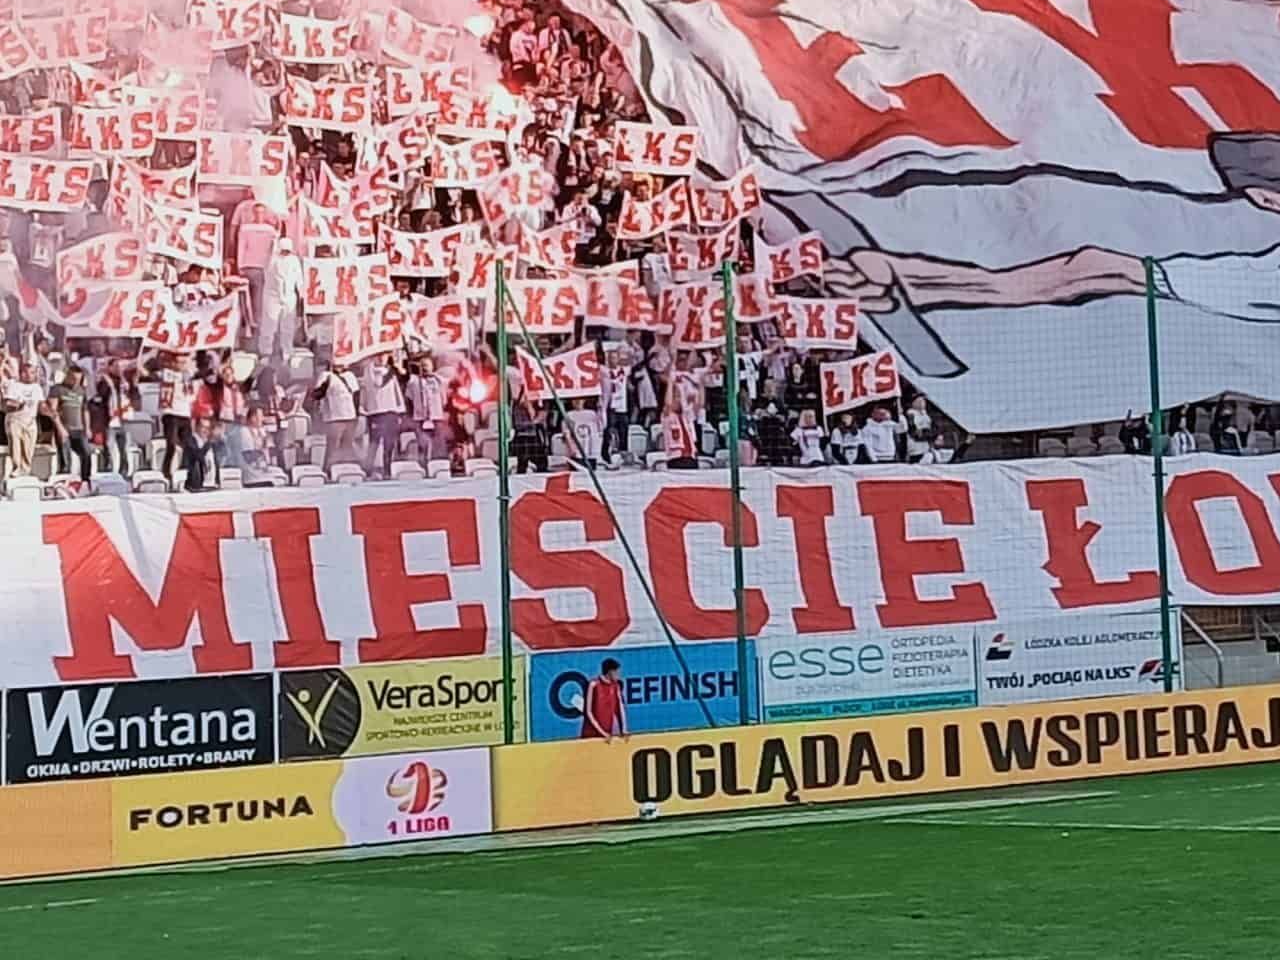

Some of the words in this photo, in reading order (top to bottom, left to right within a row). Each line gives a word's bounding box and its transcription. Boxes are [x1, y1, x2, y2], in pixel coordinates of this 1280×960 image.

[287, 83, 365, 122] ŁKS
[0, 113, 55, 152] KS
[69, 112, 154, 150] ŁKS
[616, 128, 694, 166] ŁKS
[0, 159, 89, 204] ŁKS
[770, 240, 820, 282] KS
[307, 265, 388, 307] ŁKS
[149, 304, 232, 347] ŁKS
[780, 304, 856, 340] ŁKS
[522, 352, 599, 392] ŁKS
[824, 353, 897, 408] ŁKS
[42, 472, 997, 681] MIEŚCIE
[892, 635, 956, 649] ORTOPEDIA
[769, 644, 884, 680] esse
[893, 666, 951, 679] DIETETYKA
[987, 671, 1025, 689] TWÓJ
[1085, 668, 1105, 682] NA
[28, 688, 256, 756] Wentana
[631, 724, 925, 802] OGLĄDAJ
[944, 724, 960, 777] I
[129, 795, 313, 831] FORTUNA
[388, 821, 400, 833] 1
